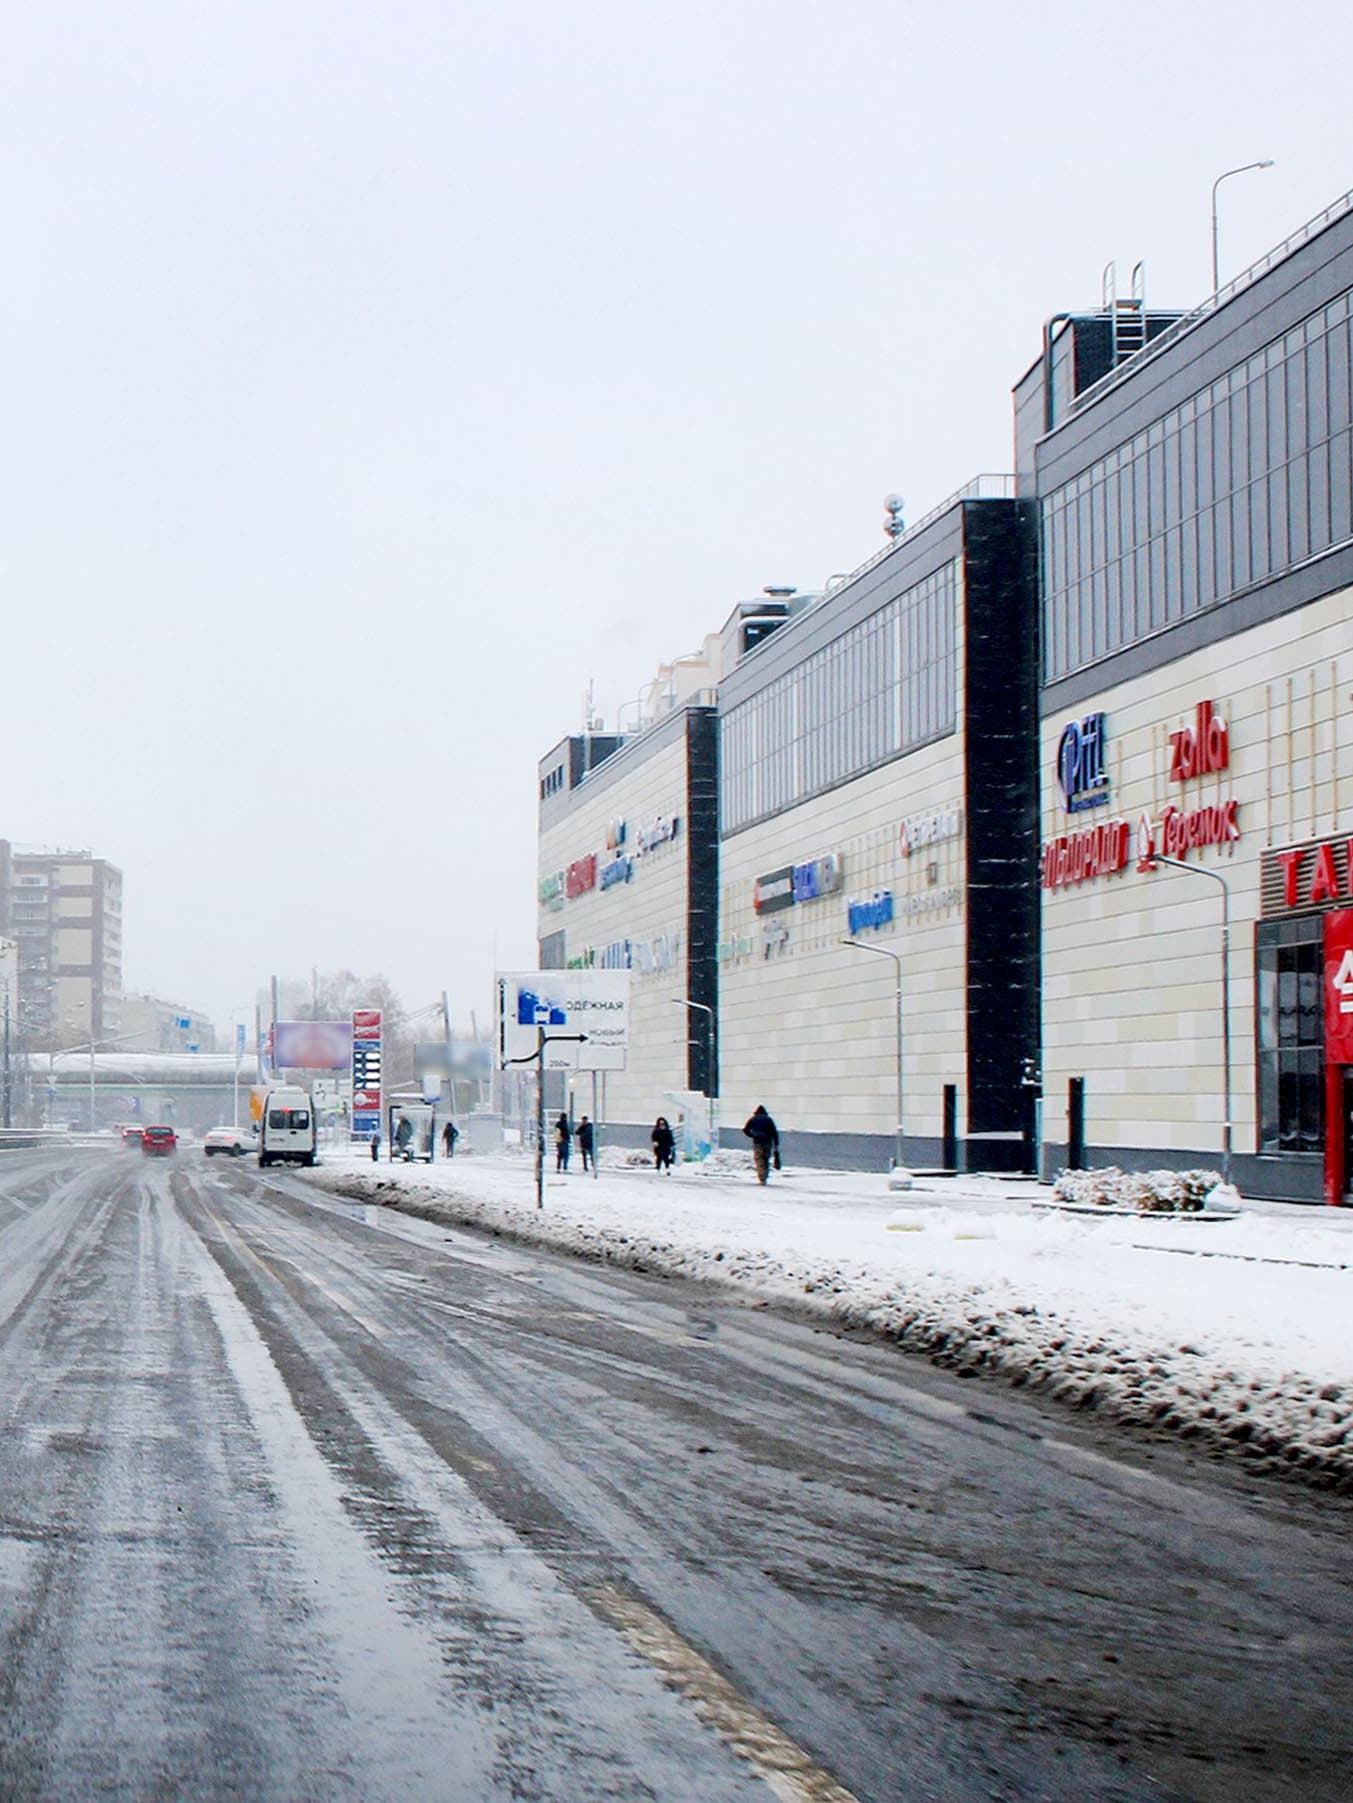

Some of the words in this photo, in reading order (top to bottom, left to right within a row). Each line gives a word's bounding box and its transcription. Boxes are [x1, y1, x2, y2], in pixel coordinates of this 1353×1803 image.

[1169, 700, 1229, 782] zolla
[1157, 798, 1241, 860] Теремок
[1277, 837, 1353, 907] ТА
